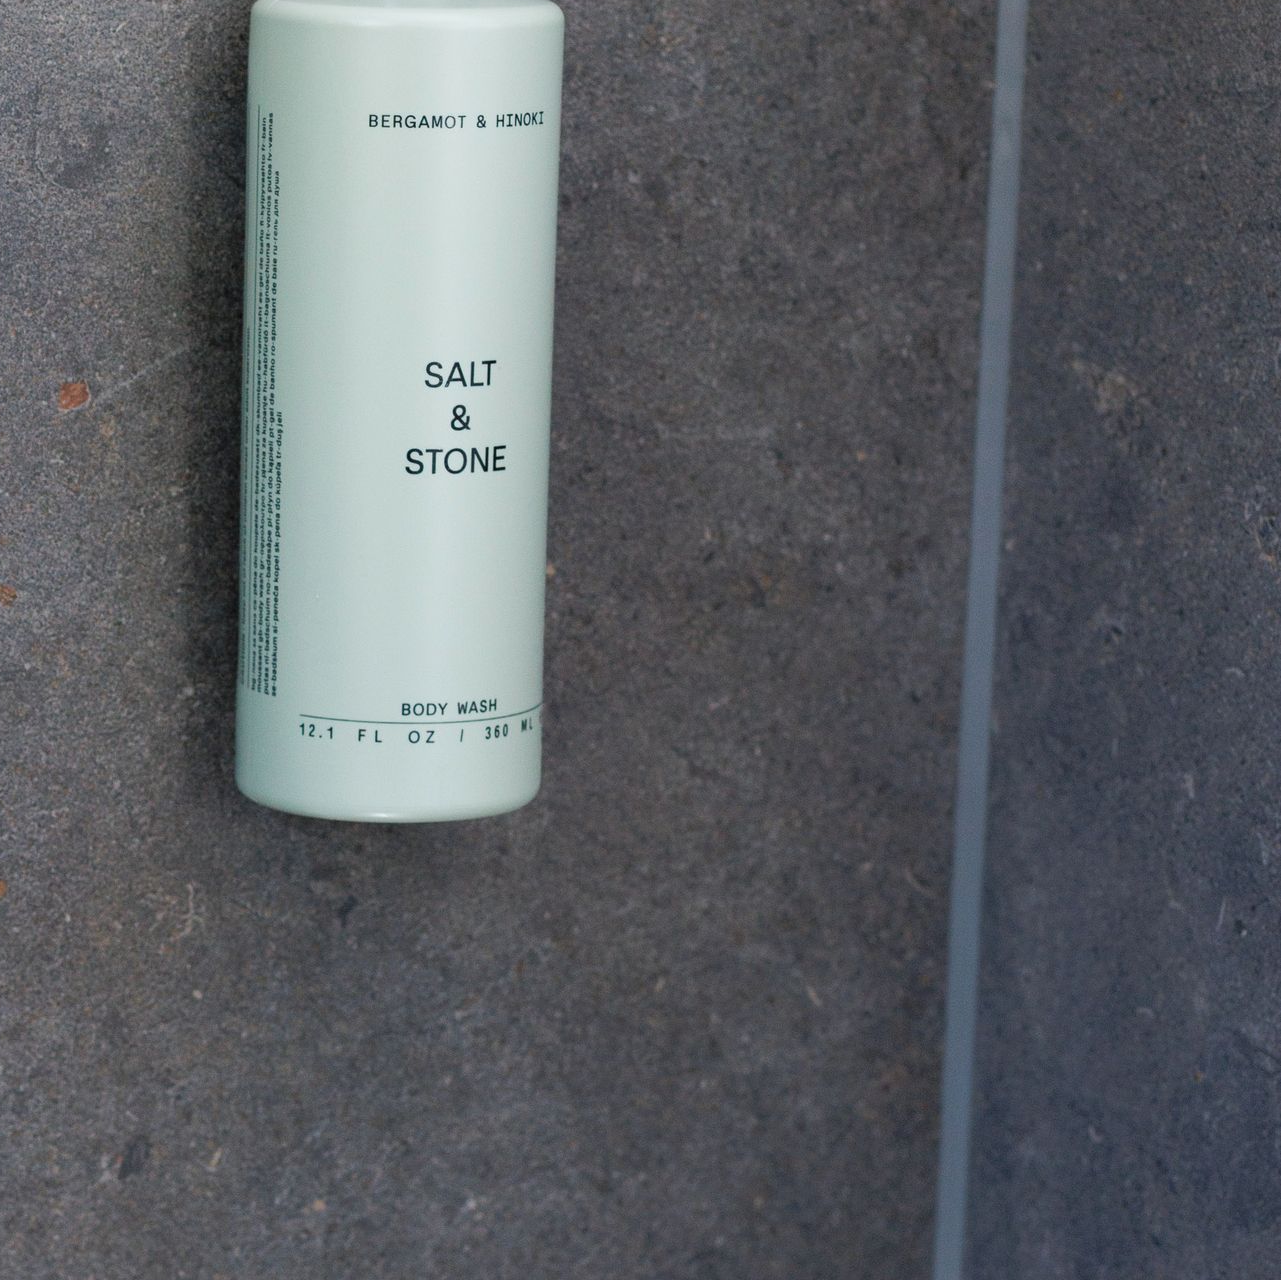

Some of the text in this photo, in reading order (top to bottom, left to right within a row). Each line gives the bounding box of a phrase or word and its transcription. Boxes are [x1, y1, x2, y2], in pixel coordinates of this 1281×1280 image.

[369, 111, 544, 129] BERGAMOT & HINOKI
[425, 360, 497, 388] SALT
[450, 404, 471, 431] &
[405, 445, 506, 475] STONE
[401, 697, 497, 716] BODY WASH
[299, 717, 532, 744] 12.1 FL OZ / 360 ML
